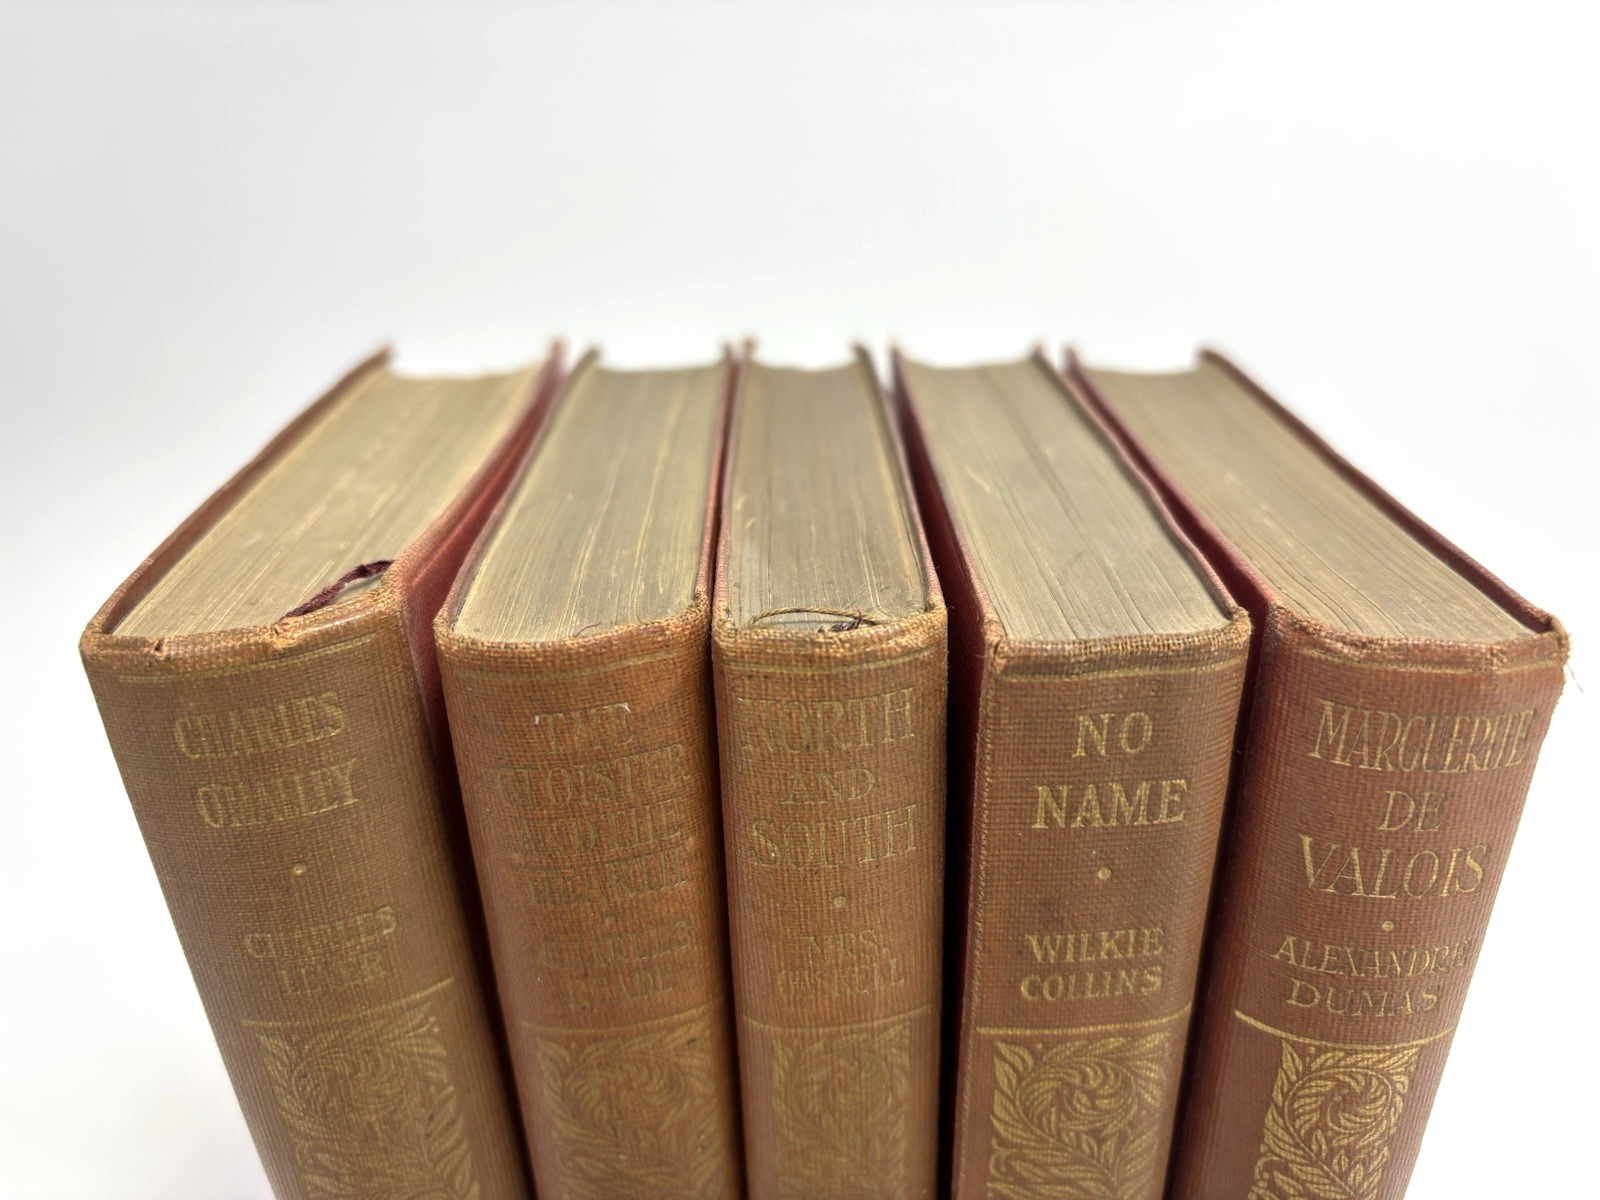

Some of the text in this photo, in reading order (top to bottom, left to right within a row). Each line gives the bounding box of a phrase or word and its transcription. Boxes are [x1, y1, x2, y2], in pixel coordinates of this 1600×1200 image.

[174, 691, 344, 760] CHARLES
[535, 701, 636, 754] THE
[737, 687, 915, 752] NORTH
[1071, 711, 1153, 758] NO
[1306, 699, 1536, 773] MARGUERITE
[497, 742, 690, 811] CLOISTER
[780, 767, 880, 805] AND
[600, 799, 682, 853] THE
[1031, 779, 1187, 829] NAME
[1376, 790, 1446, 832] DE
[752, 803, 917, 869] SOUTH
[1297, 832, 1487, 899] VALOIS
[1026, 927, 1164, 964] WILKIE
[1270, 935, 1470, 978] ALEXANDRE
[1020, 966, 1163, 1001] COLLINS
[1286, 977, 1440, 1017] DUMAS
